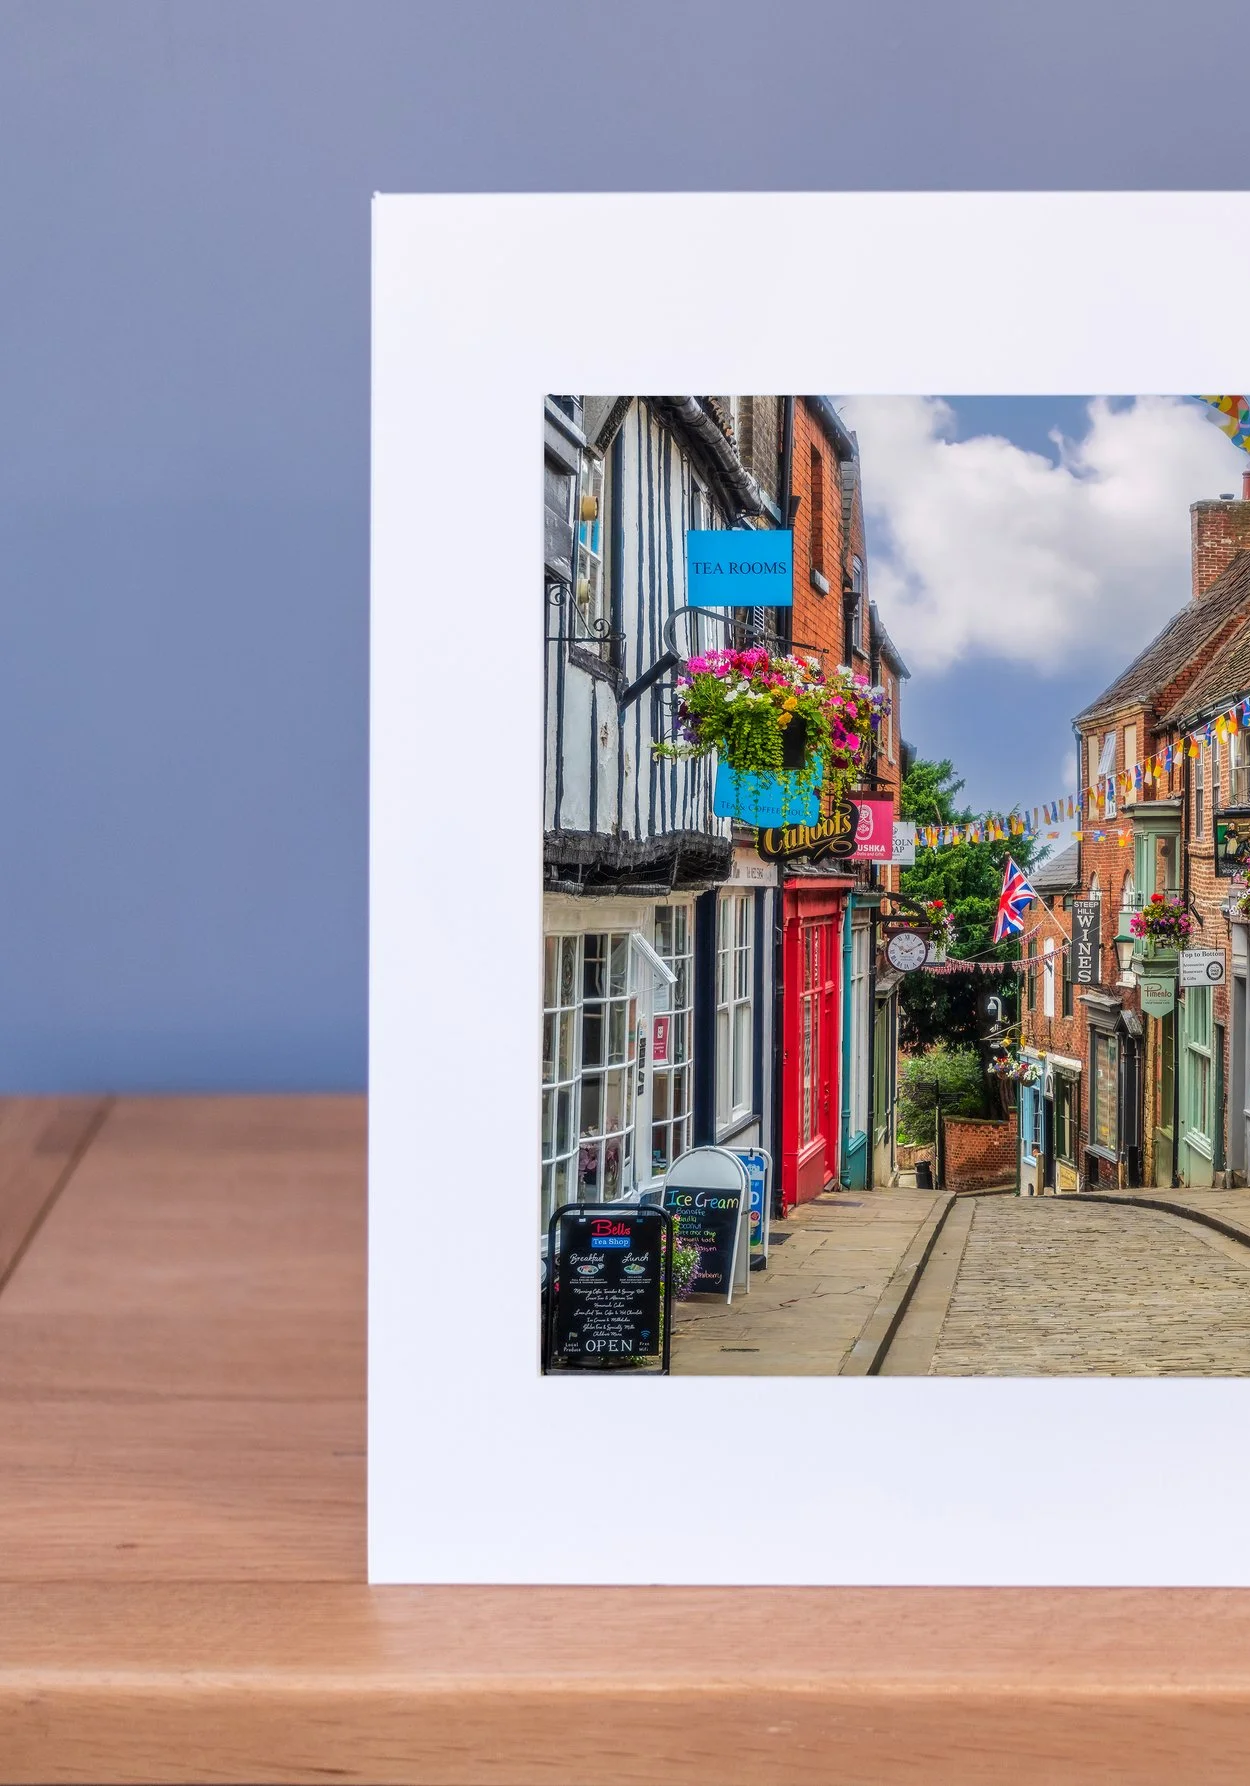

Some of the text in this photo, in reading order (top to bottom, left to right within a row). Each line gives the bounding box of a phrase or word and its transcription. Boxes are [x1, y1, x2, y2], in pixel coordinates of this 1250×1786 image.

[692, 561, 787, 575] TEA ROOMS
[1077, 915, 1095, 983] WINES
[1144, 982, 1172, 998] Pimento
[666, 1190, 692, 1206] Ice
[695, 1192, 739, 1210] Cream
[591, 1218, 631, 1236] Bells
[608, 1238, 629, 1247] Shop
[569, 1252, 605, 1265] Breakfast
[622, 1252, 650, 1264] Lunch
[585, 1340, 633, 1352] OPEN
